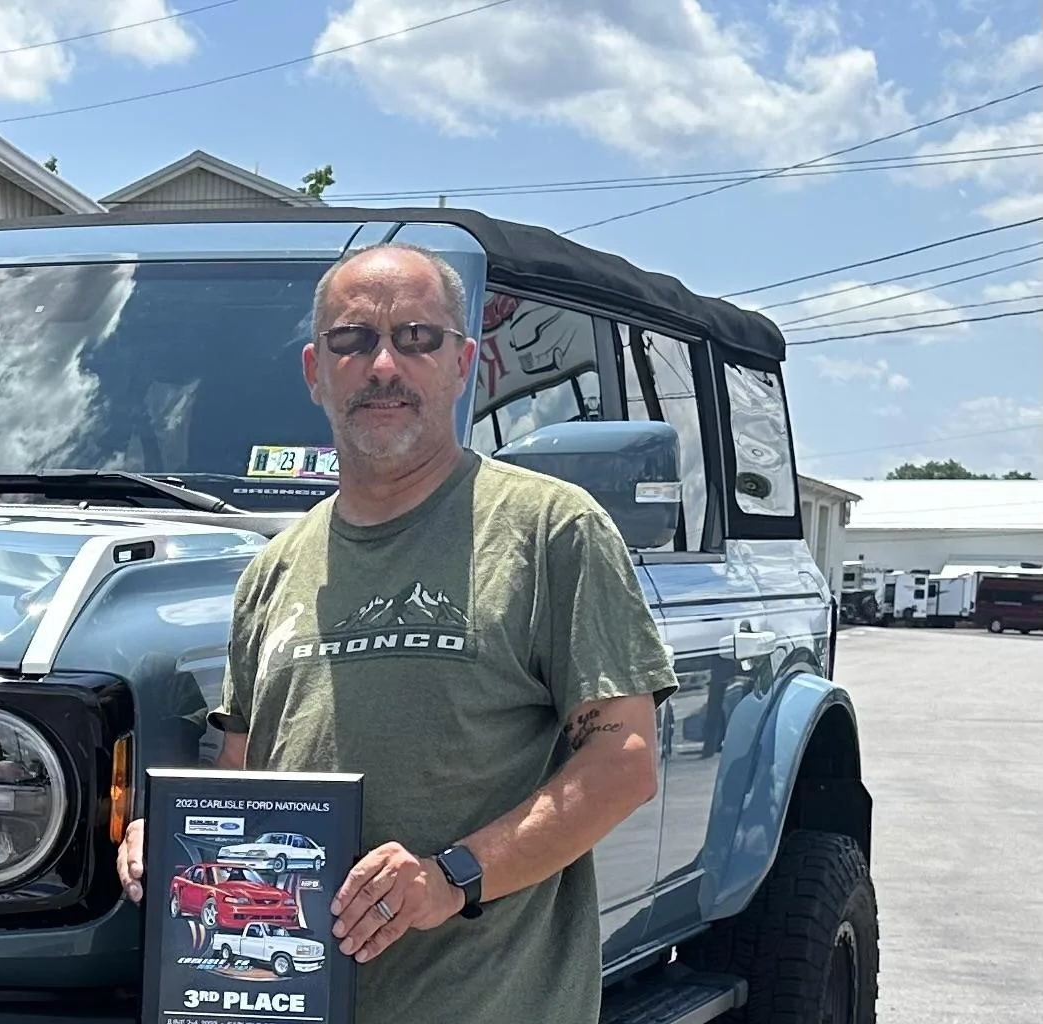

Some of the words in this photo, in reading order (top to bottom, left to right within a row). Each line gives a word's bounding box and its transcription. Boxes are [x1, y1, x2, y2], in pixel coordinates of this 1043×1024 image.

[280, 451, 296, 471] 23
[233, 488, 326, 496] BRONCO
[292, 633, 465, 660] BRONCO
[175, 798, 198, 809] 2023
[199, 800, 245, 810] CARLISLE
[246, 801, 274, 811] FORD
[275, 802, 330, 812] NATIONALS
[183, 989, 220, 1008] 3RD
[223, 991, 305, 1013] PLACE
